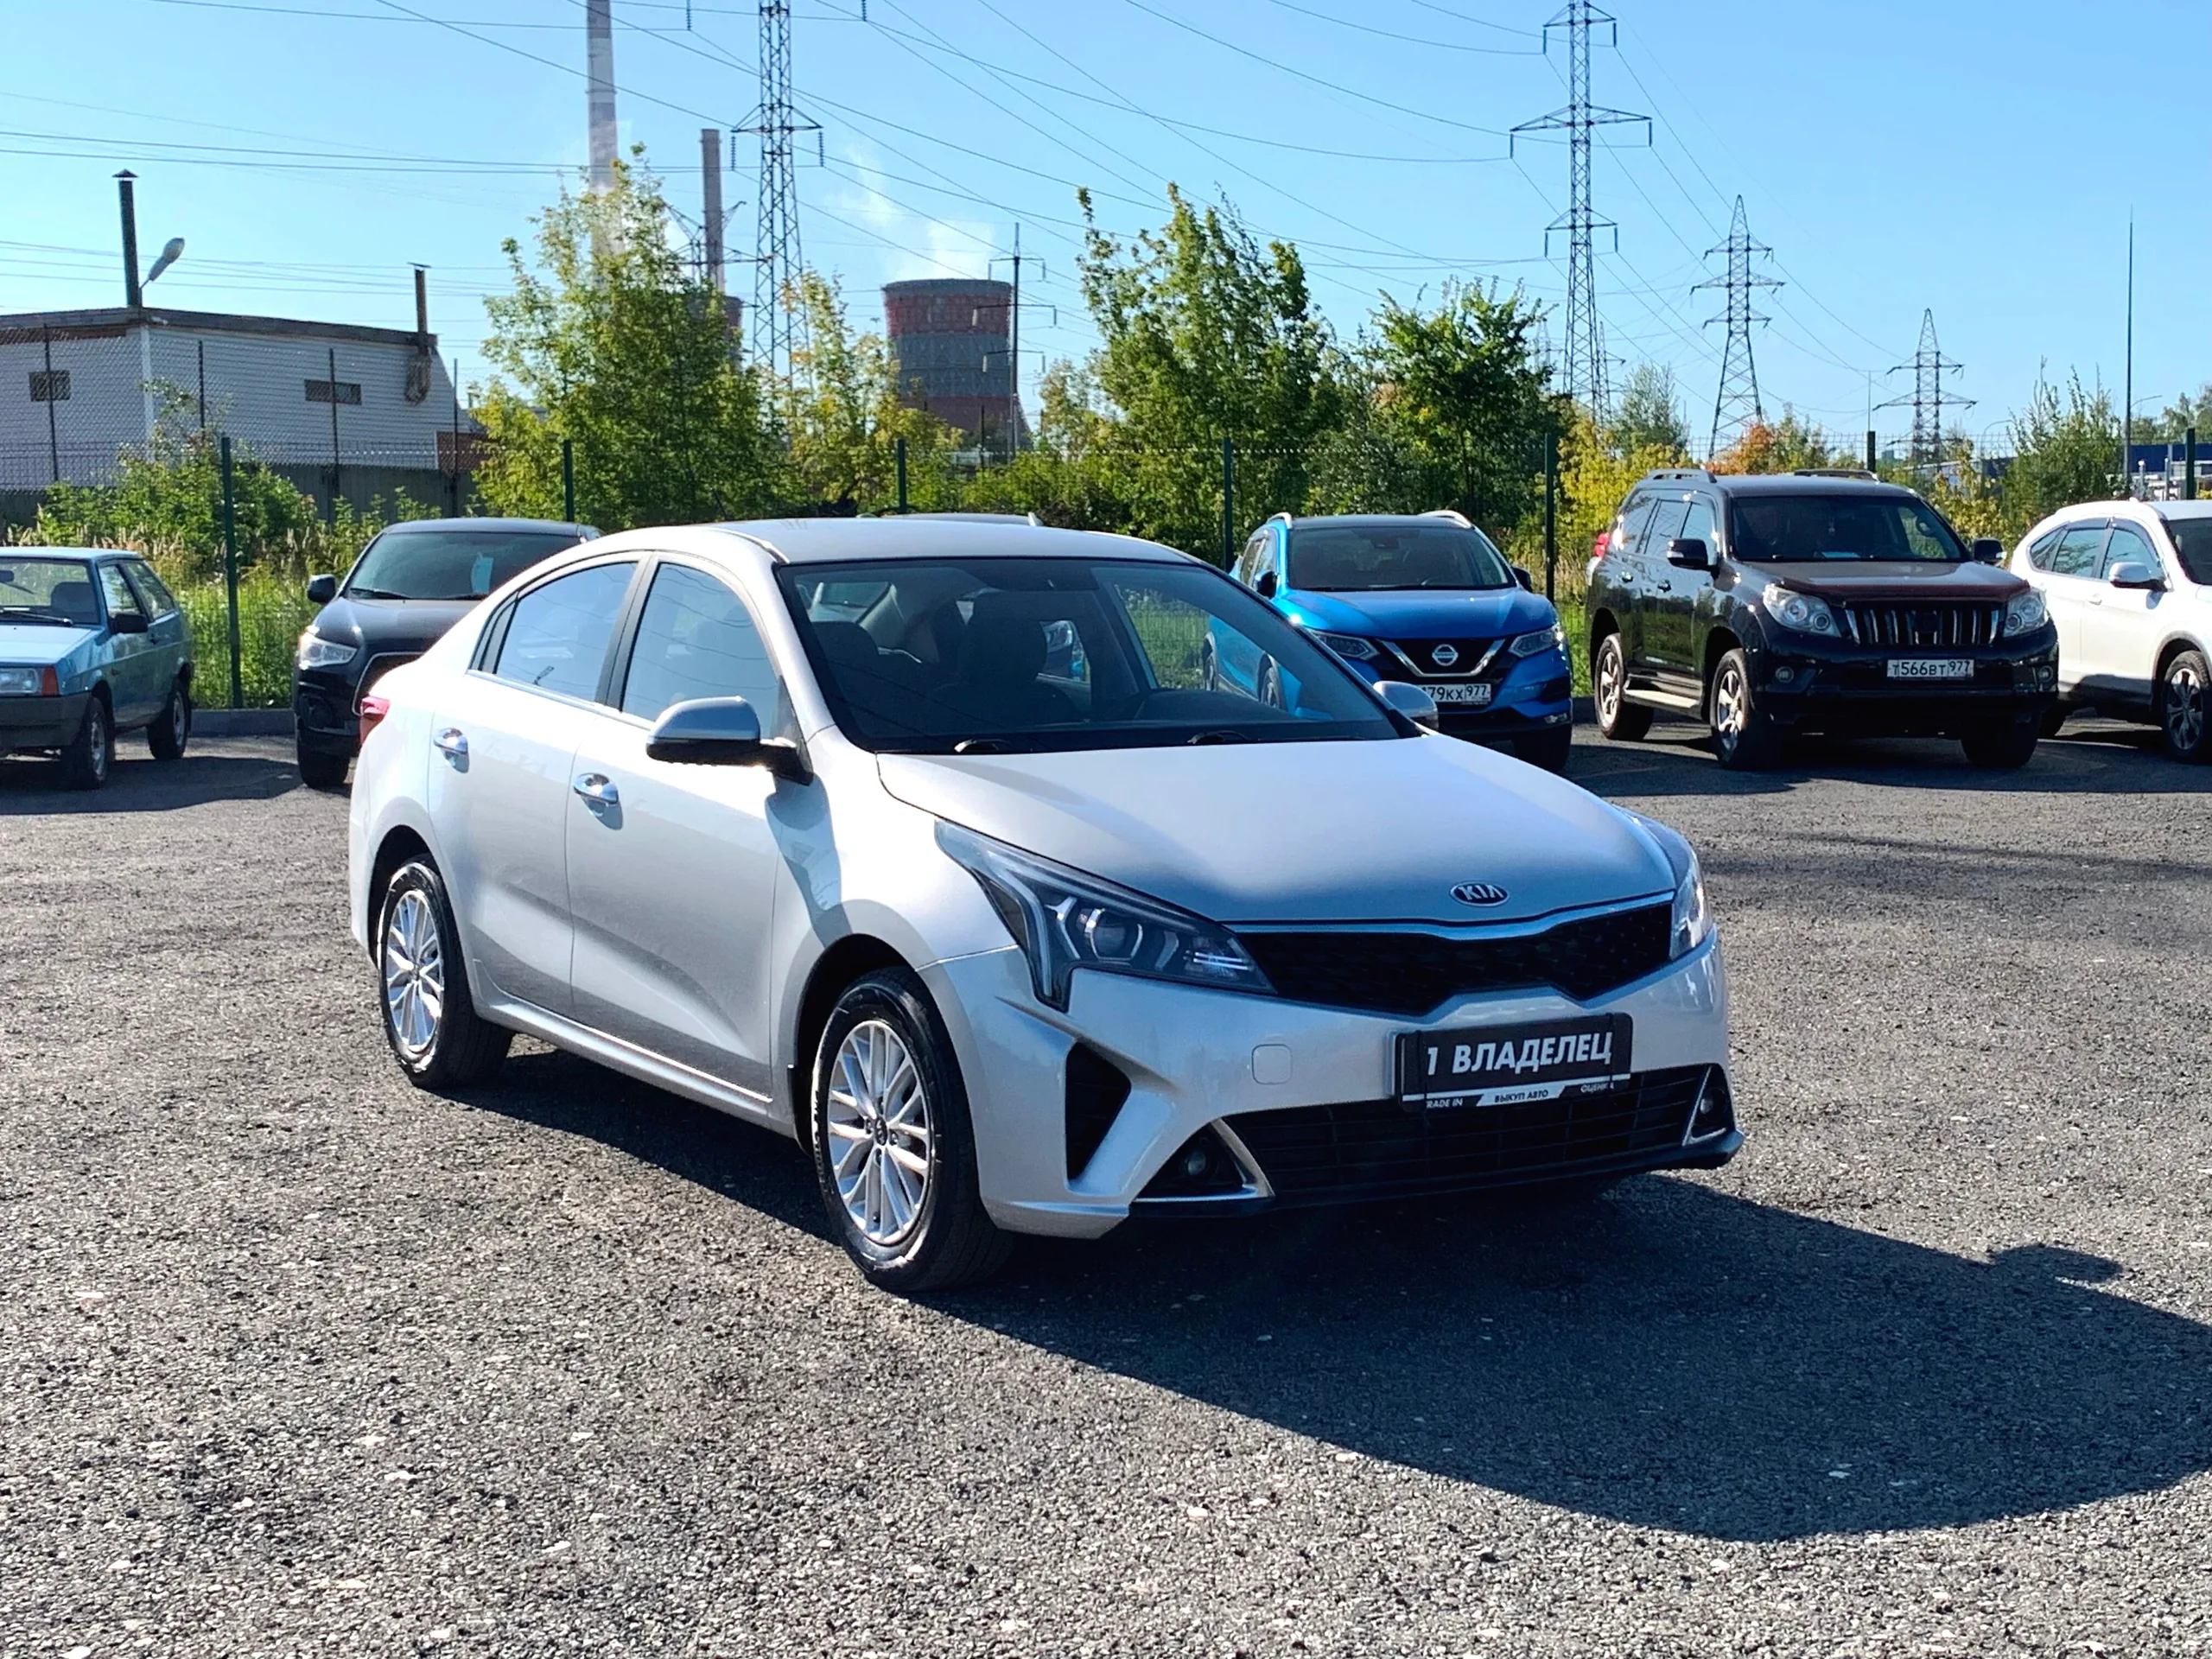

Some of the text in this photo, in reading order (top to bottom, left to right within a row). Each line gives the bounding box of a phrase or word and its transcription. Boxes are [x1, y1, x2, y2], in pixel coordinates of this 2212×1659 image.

[1458, 884, 1504, 900] KIA
[1427, 1032, 1613, 1076] 1 ВЛАДЕЛЕЦ
[1426, 1097, 1464, 1109] RADE IN
[1494, 1089, 1549, 1103] ВЫКУП АВТО
